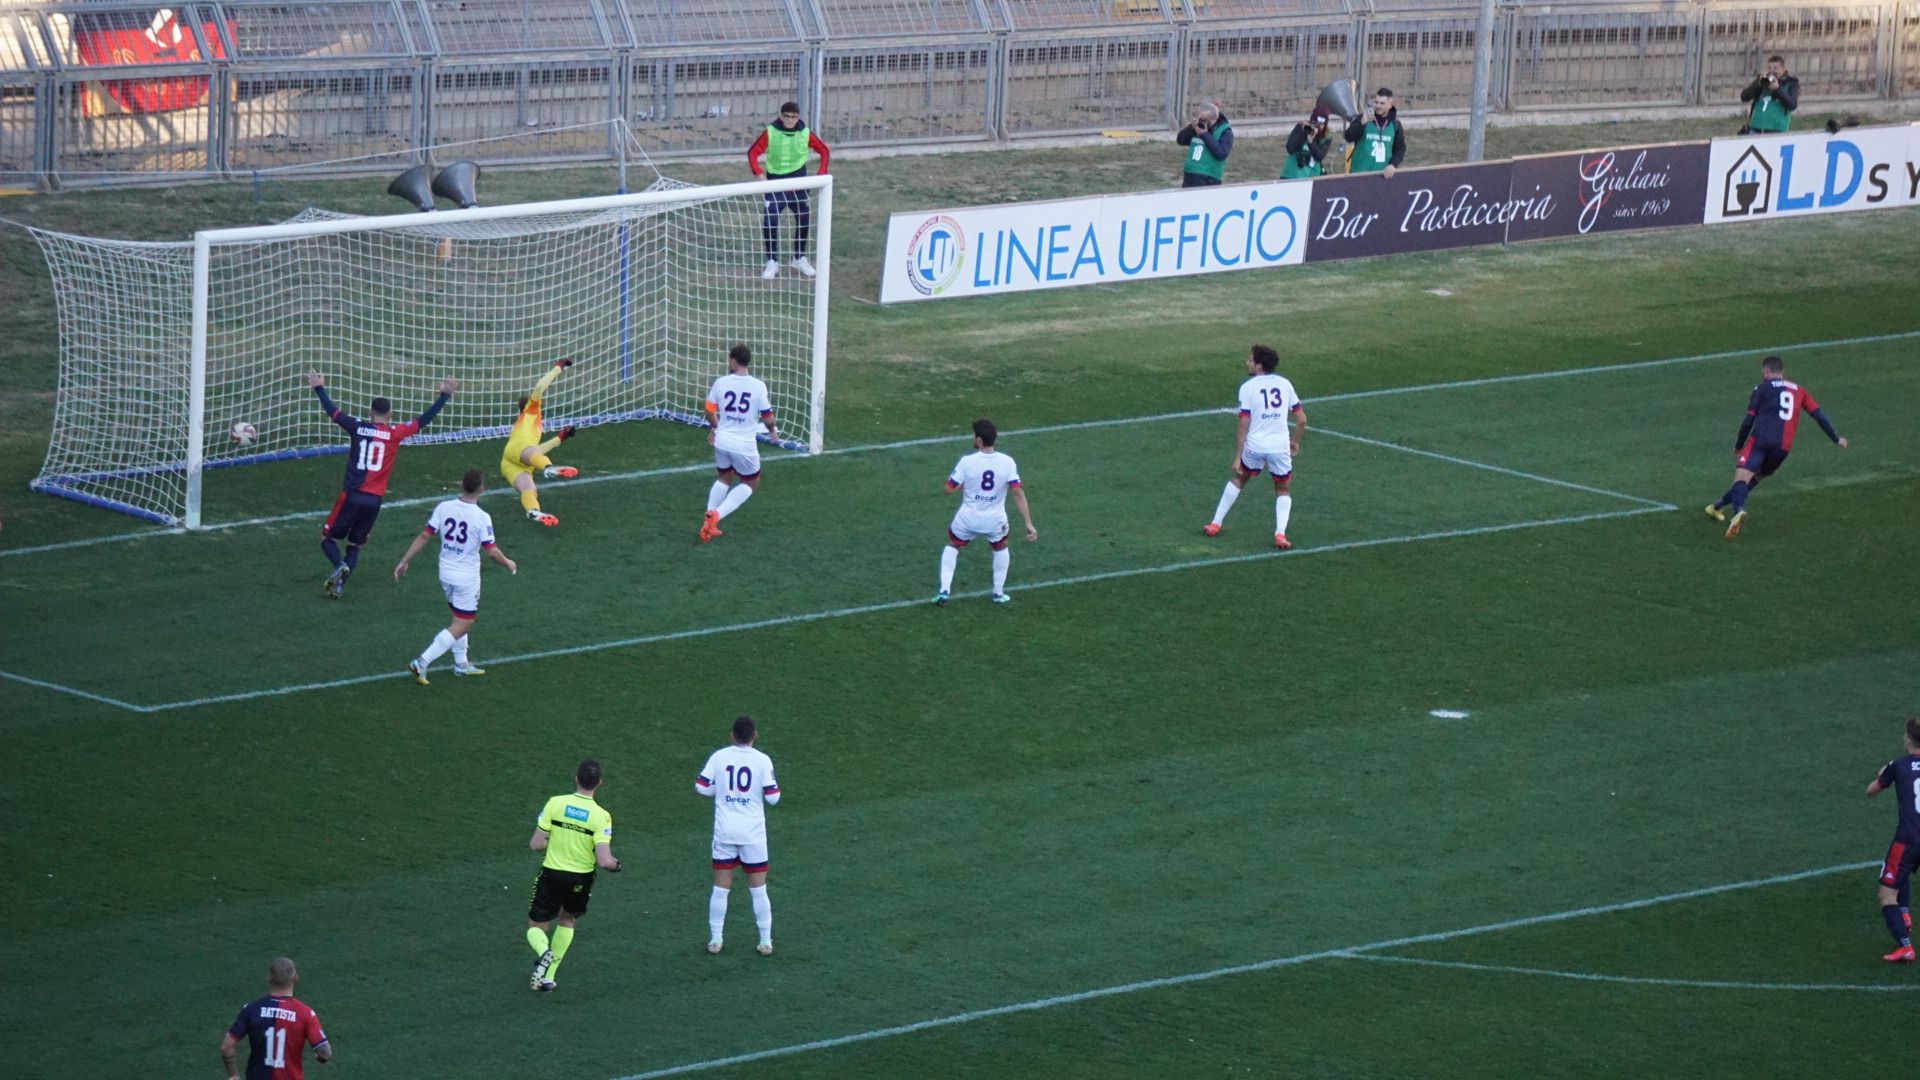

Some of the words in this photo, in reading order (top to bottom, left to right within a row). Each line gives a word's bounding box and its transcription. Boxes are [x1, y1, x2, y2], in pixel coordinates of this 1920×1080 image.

[1578, 150, 1670, 234] Giuliani
[1316, 197, 1379, 240] Bar
[1400, 184, 1557, 232] Pasticceria
[1612, 204, 1637, 218] since
[1640, 199, 1671, 216] 1969
[973, 221, 1105, 288] LINEA
[724, 390, 751, 414] 25
[1260, 387, 1283, 410] 13
[1779, 391, 1794, 421] 9
[357, 439, 385, 472] 10
[981, 470, 995, 491] 8
[444, 517, 468, 544] 23
[725, 765, 752, 793] 10
[261, 1007, 297, 1022] BATTISTA
[264, 1027, 286, 1068] 11
